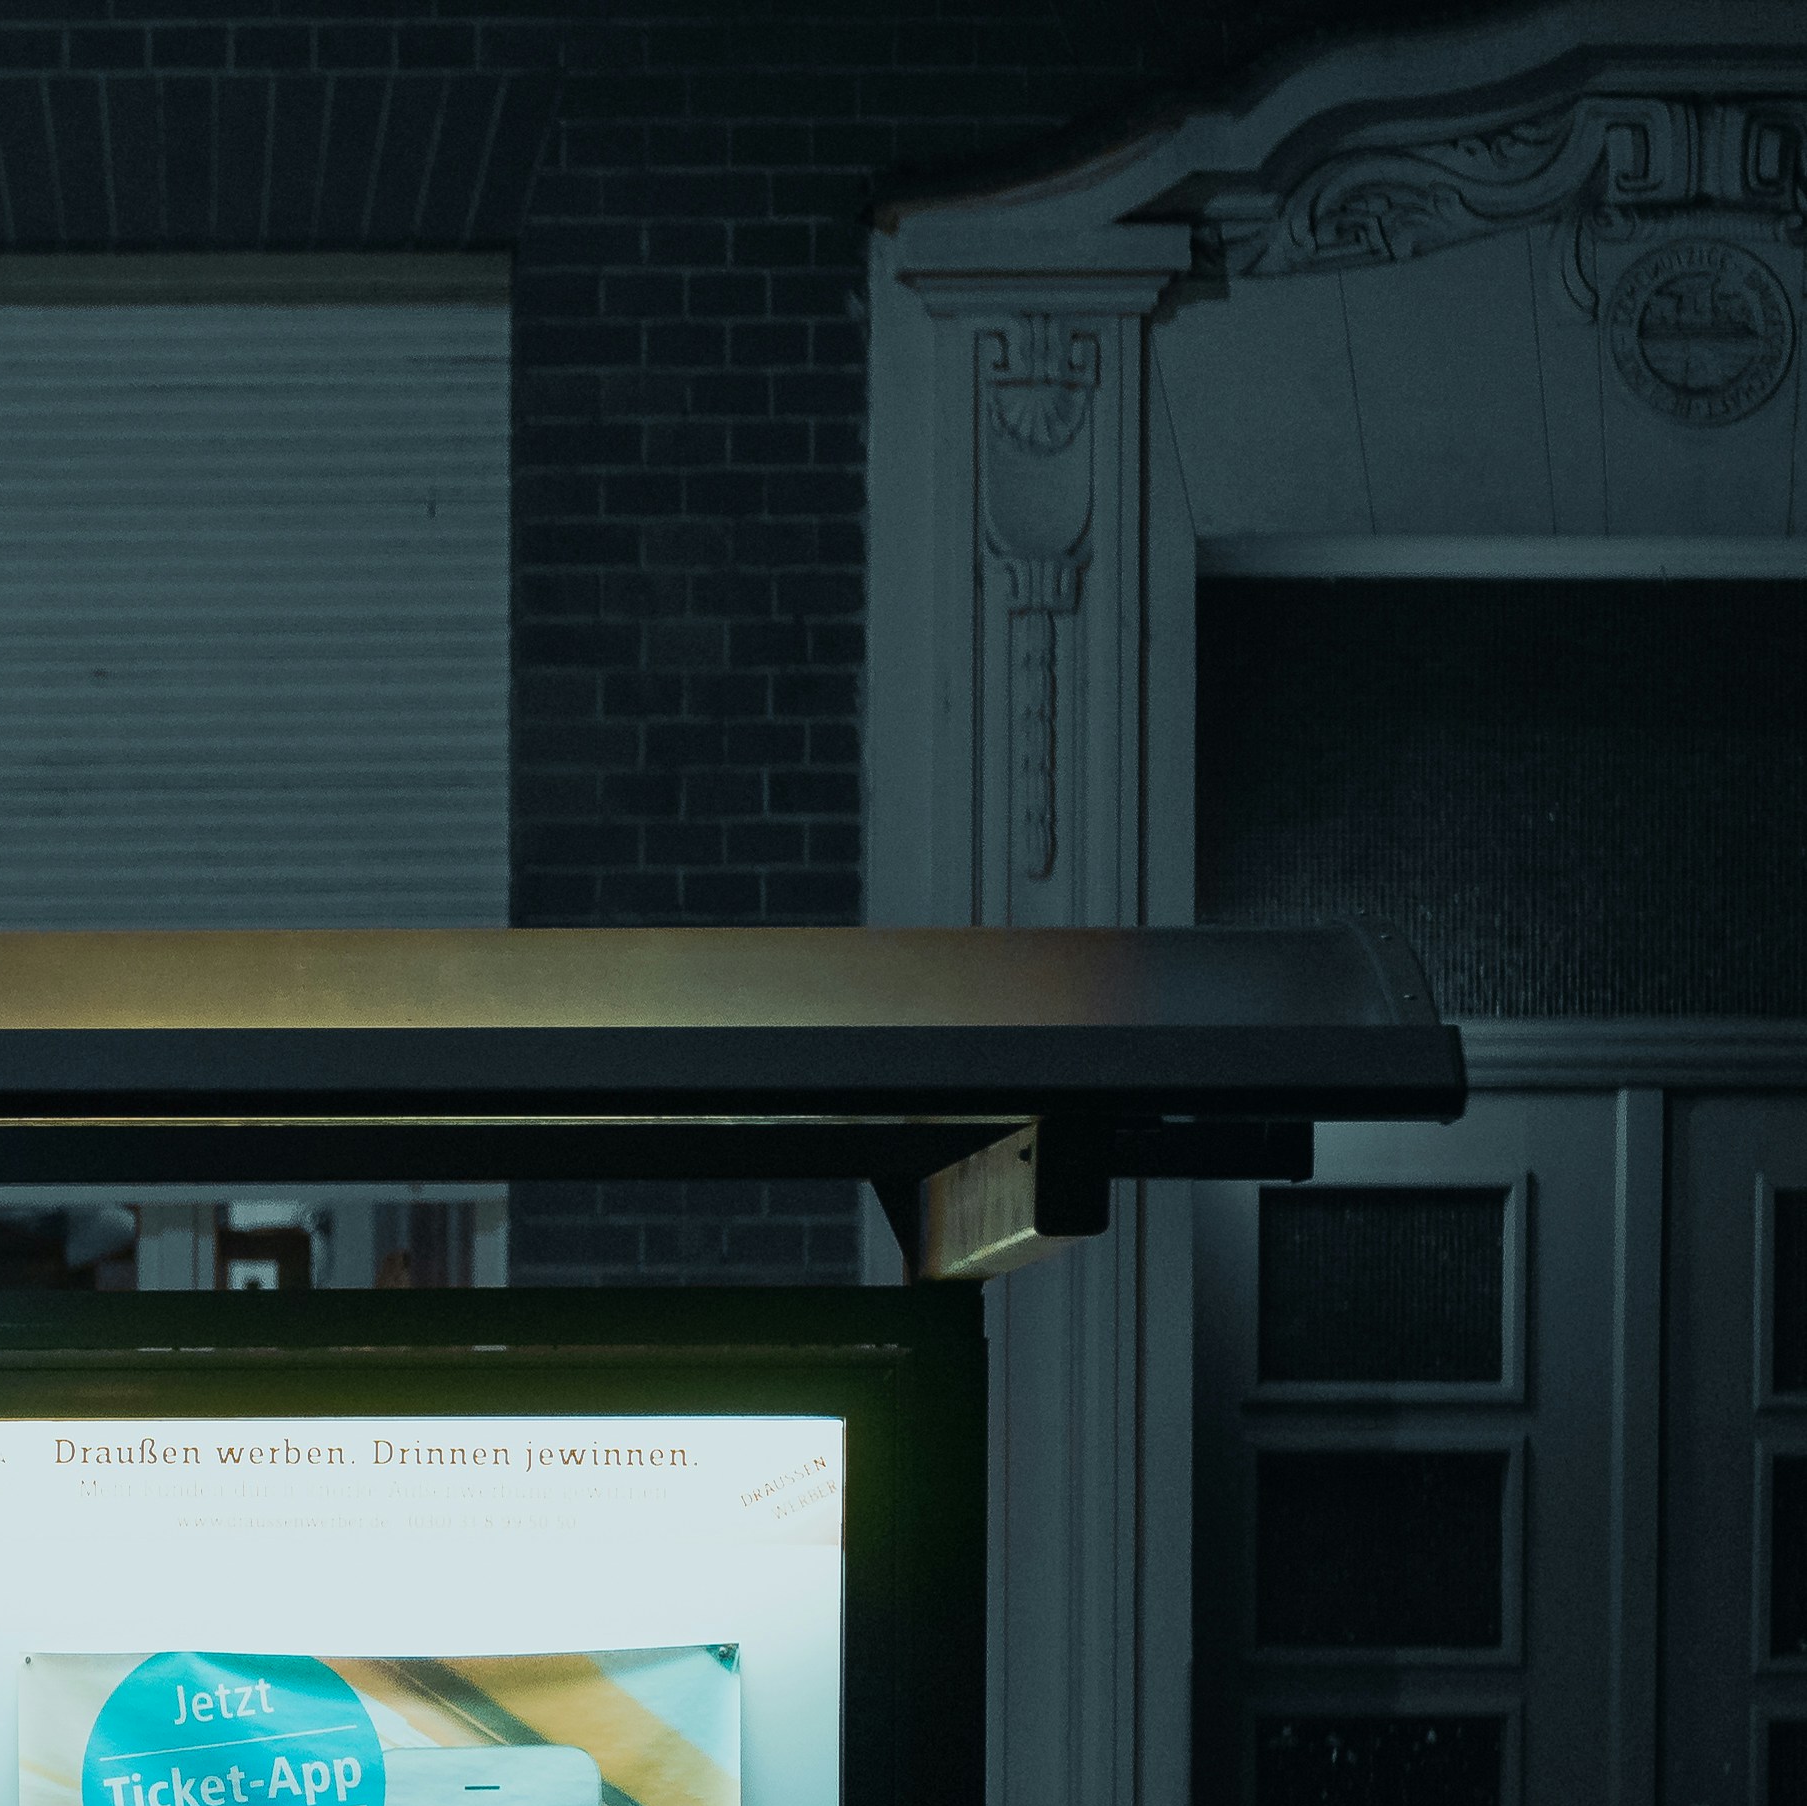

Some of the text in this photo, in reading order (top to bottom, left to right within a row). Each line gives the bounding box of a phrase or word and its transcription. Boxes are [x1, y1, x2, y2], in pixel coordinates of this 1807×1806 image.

[54, 1437, 699, 1473] Draußen werben. Drinnen jewinnen.
[739, 1456, 828, 1508] DRAUSSEN
[173, 1678, 275, 1725] Jetzt
